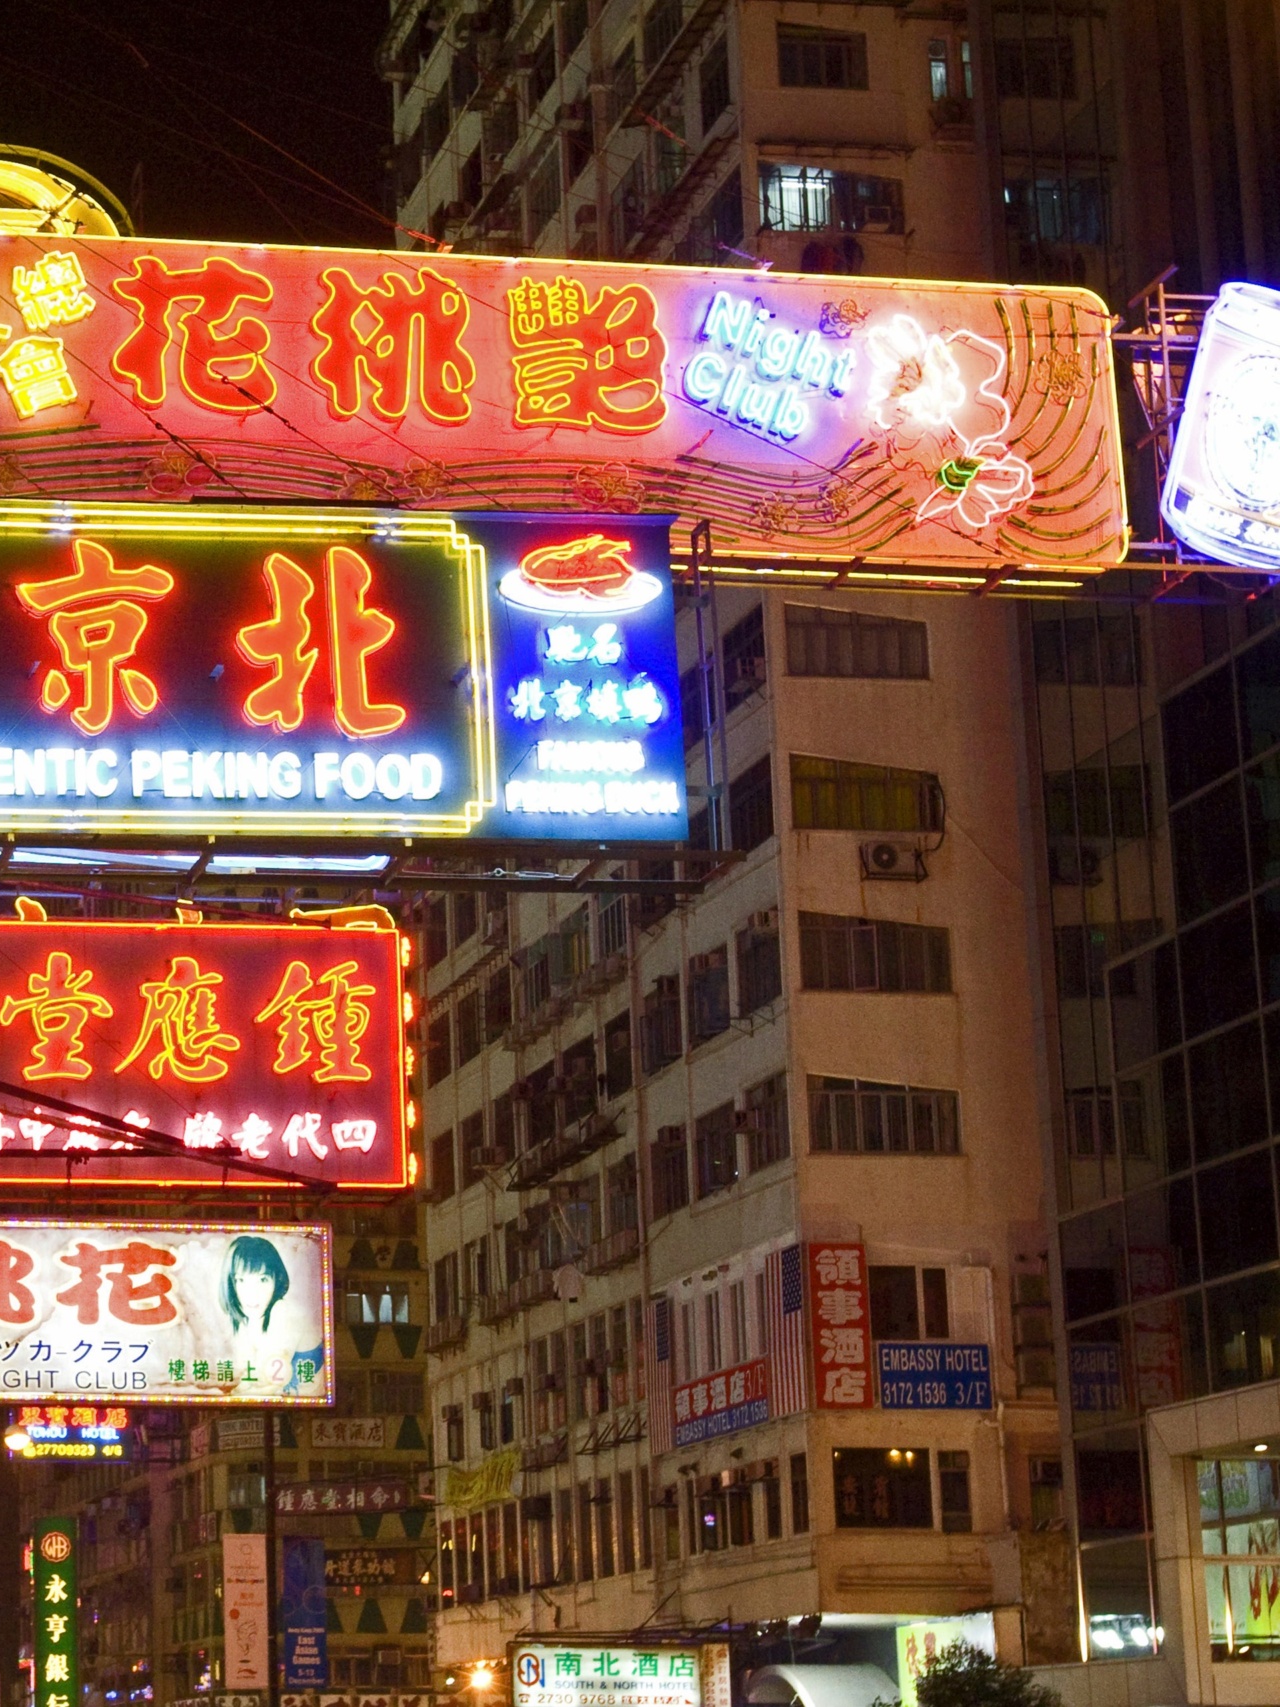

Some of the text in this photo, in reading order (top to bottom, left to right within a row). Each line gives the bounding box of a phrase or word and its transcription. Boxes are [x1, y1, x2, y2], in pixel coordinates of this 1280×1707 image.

[701, 289, 858, 400] Night
[682, 353, 810, 443] Club
[131, 751, 303, 799] PEKING
[314, 753, 443, 802] FOOD
[815, 1250, 866, 1405] 領事酒店
[882, 1350, 988, 1372] EMBASSY HOTEL
[75, 1370, 148, 1390] CLUB
[745, 1364, 766, 1400] 3/F
[884, 1382, 987, 1406] 3172 1536 3/F
[676, 1418, 707, 1446] EMBASSY
[707, 1413, 730, 1434] HOTEL
[295, 1645, 319, 1655] Asian
[297, 1636, 315, 1645] East
[292, 1655, 320, 1665] Games
[554, 1652, 696, 1677] 南北酒店
[554, 1681, 697, 1691] SOUTH & NORTH HOTEL
[537, 1693, 573, 1704] 2730
[580, 1694, 616, 1705] 9768
